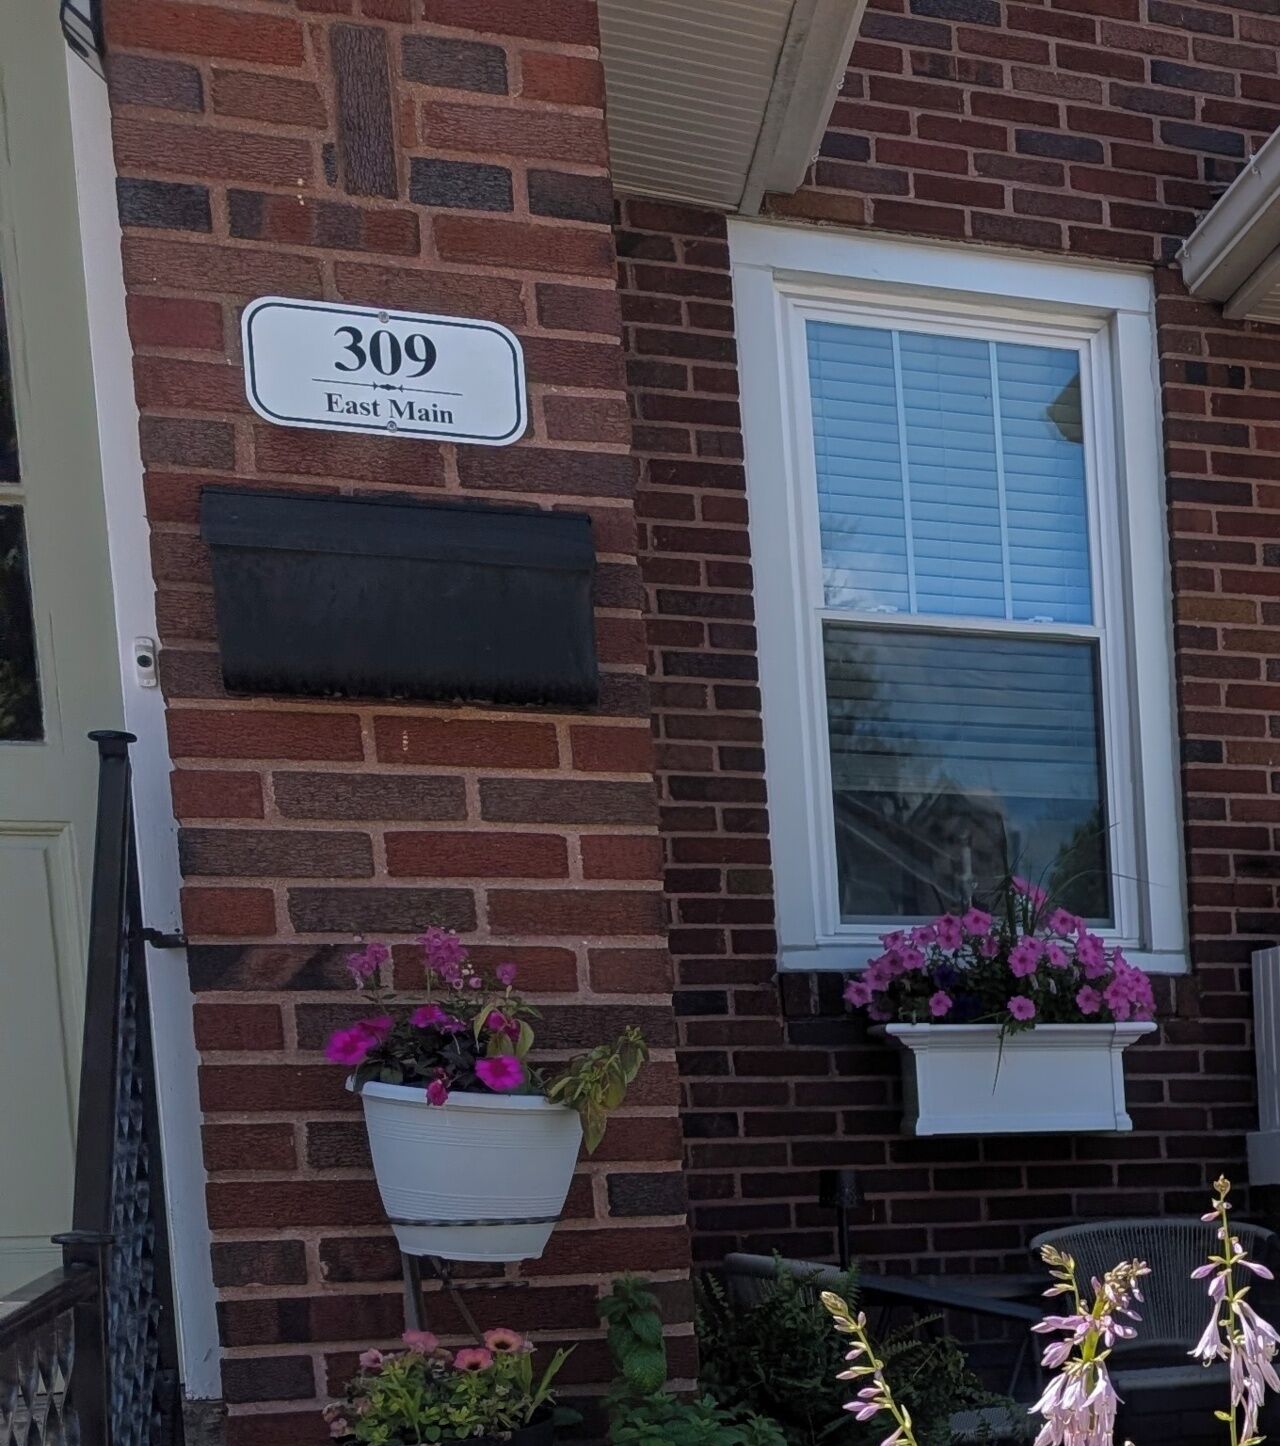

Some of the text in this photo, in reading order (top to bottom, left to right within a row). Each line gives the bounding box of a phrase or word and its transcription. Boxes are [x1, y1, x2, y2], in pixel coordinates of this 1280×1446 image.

[333, 325, 437, 378] 309
[324, 391, 454, 424] East Main
